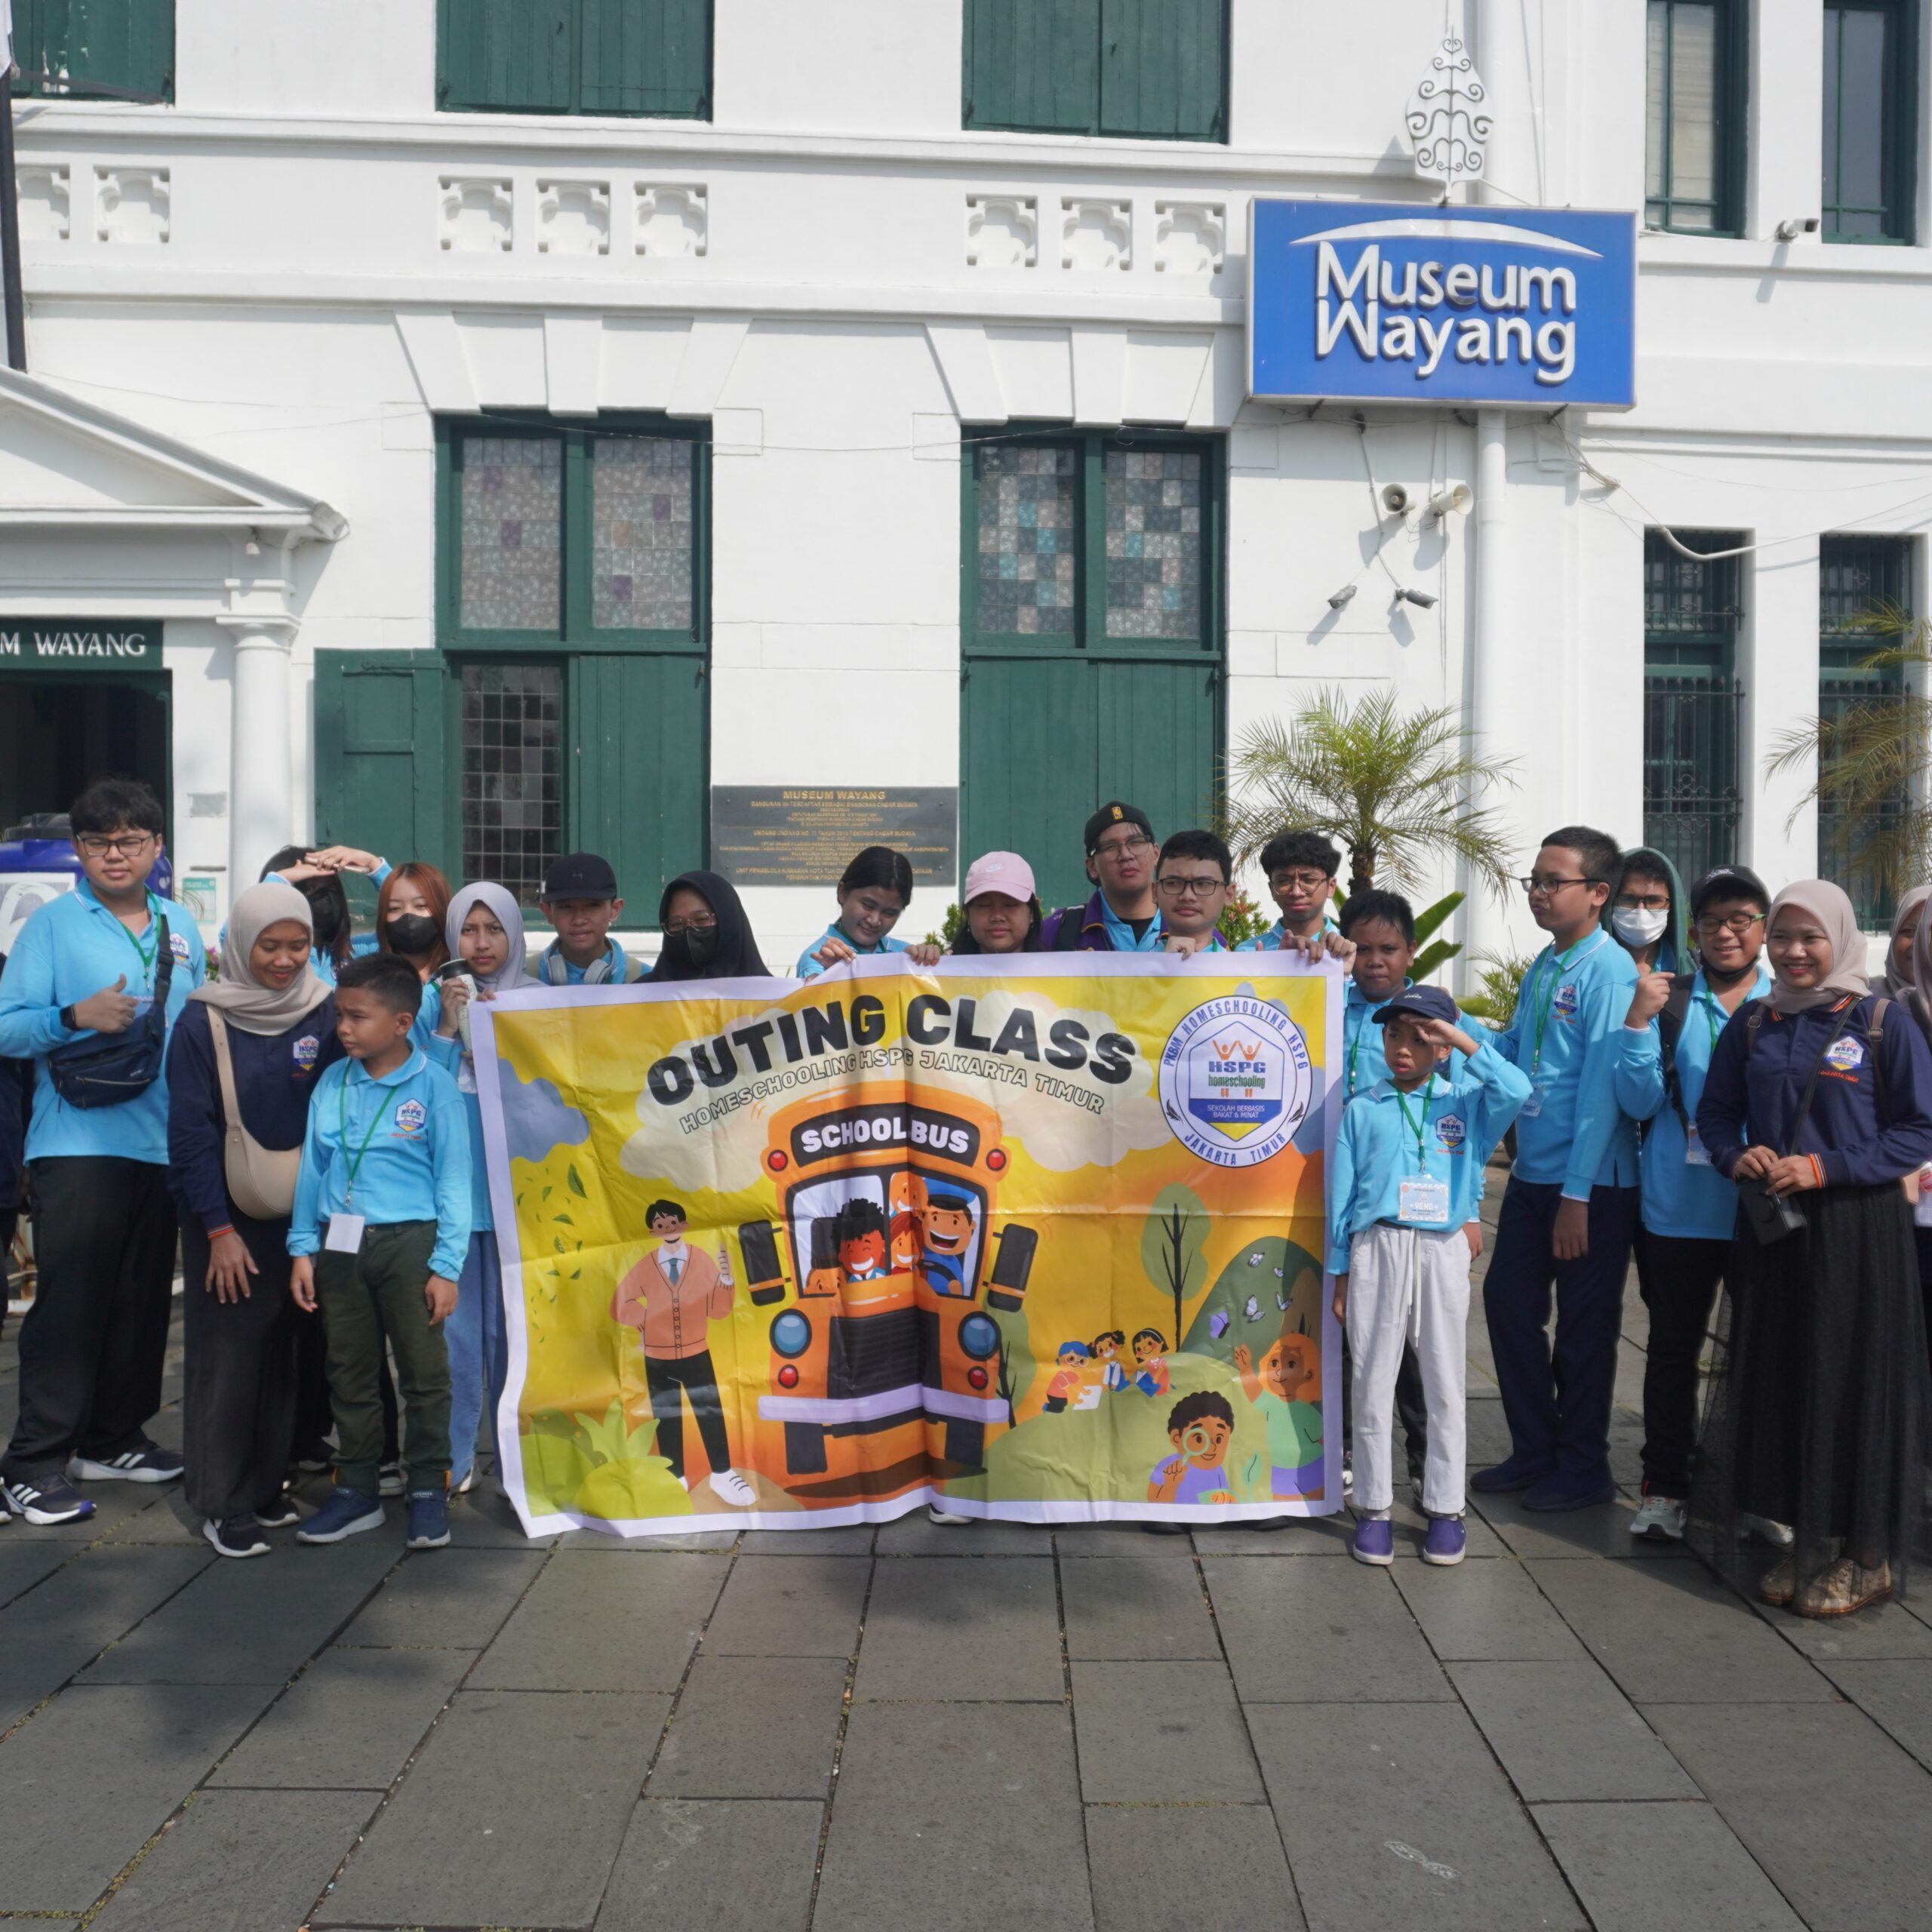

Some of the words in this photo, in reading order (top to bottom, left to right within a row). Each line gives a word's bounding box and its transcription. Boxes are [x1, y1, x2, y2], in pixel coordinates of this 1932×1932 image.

[1316, 241, 1577, 312] Museum
[1315, 299, 1577, 385] Wayang
[34, 632, 146, 657] WAYANG
[783, 790, 834, 799] MUSEUM
[837, 791, 886, 799] WAYANG
[647, 995, 886, 1106] OUTING
[906, 994, 1136, 1084] CLASS
[1163, 1036, 1183, 1068] PKBM
[1181, 1000, 1287, 1035] HOMESCHOOLING
[1287, 1034, 1309, 1069] HSPG
[1208, 1060, 1266, 1073] HSPG
[1208, 1074, 1266, 1089] homeschooling
[679, 1054, 856, 1134] HOMESCHOOLING
[859, 1048, 914, 1069] HSPG
[919, 1051, 1027, 1087] JAKARTA
[1035, 1073, 1104, 1115] TIMUR
[801, 1117, 906, 1152] SCHOOL
[910, 1119, 970, 1154] BUS
[1184, 1133, 1237, 1165] JAKARTA
[1250, 1132, 1287, 1163] TIMUR
